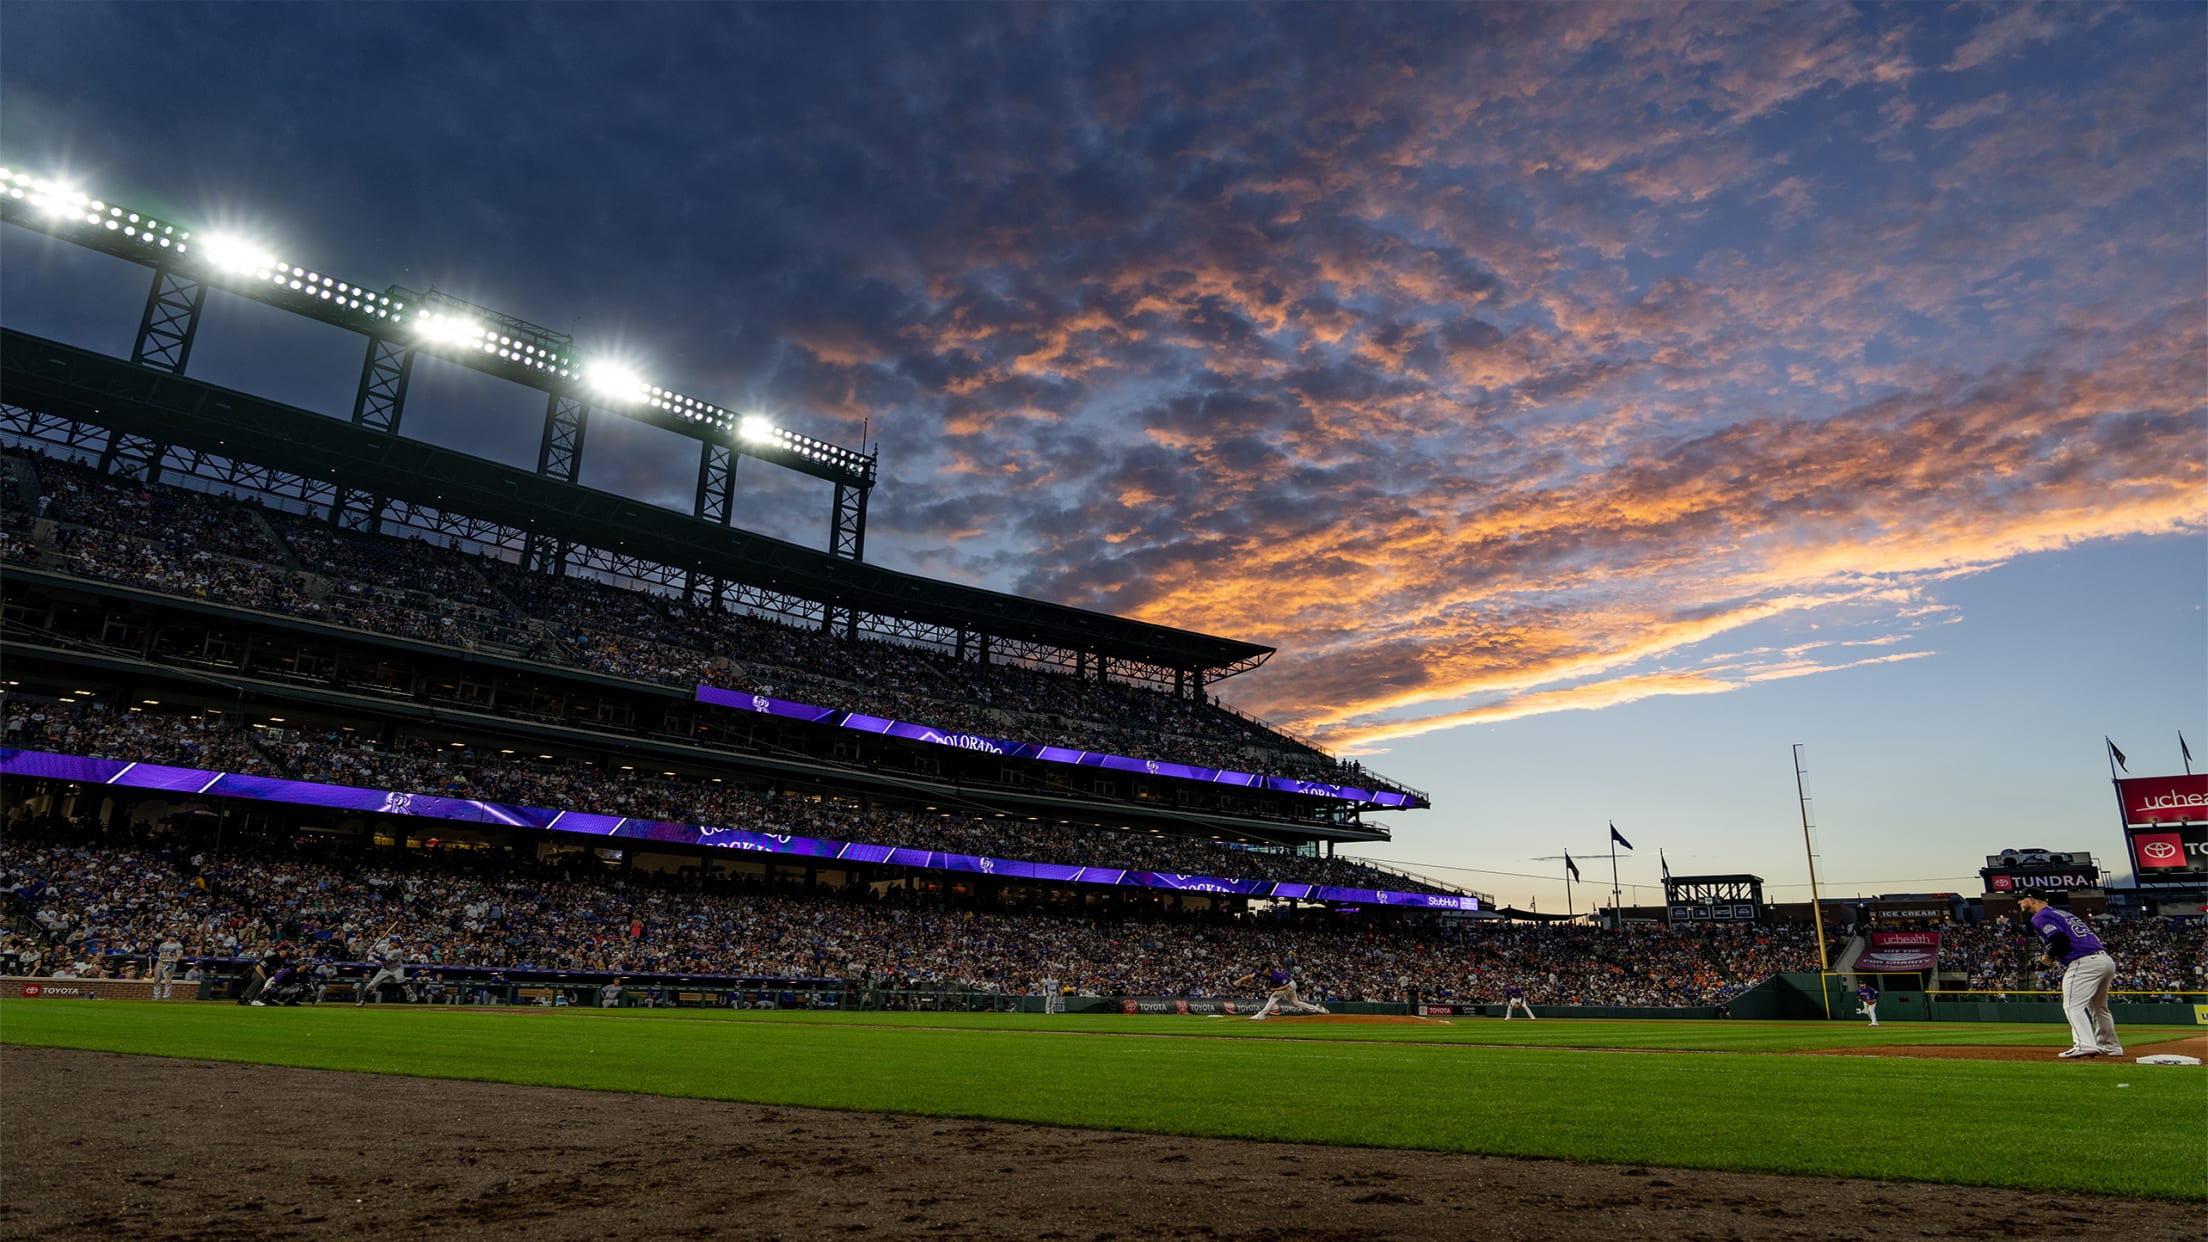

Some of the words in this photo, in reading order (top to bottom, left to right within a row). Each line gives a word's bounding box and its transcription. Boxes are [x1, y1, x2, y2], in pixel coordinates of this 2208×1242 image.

[2011, 875, 2089, 888] TUNDRA
[1428, 896, 1458, 907] StubHub
[1883, 934, 1931, 945] uchealth
[1139, 1003, 1168, 1011] TOYOTA
[1190, 1004, 1216, 1012] TOYOTA
[1237, 1004, 1261, 1012] TOYOTA
